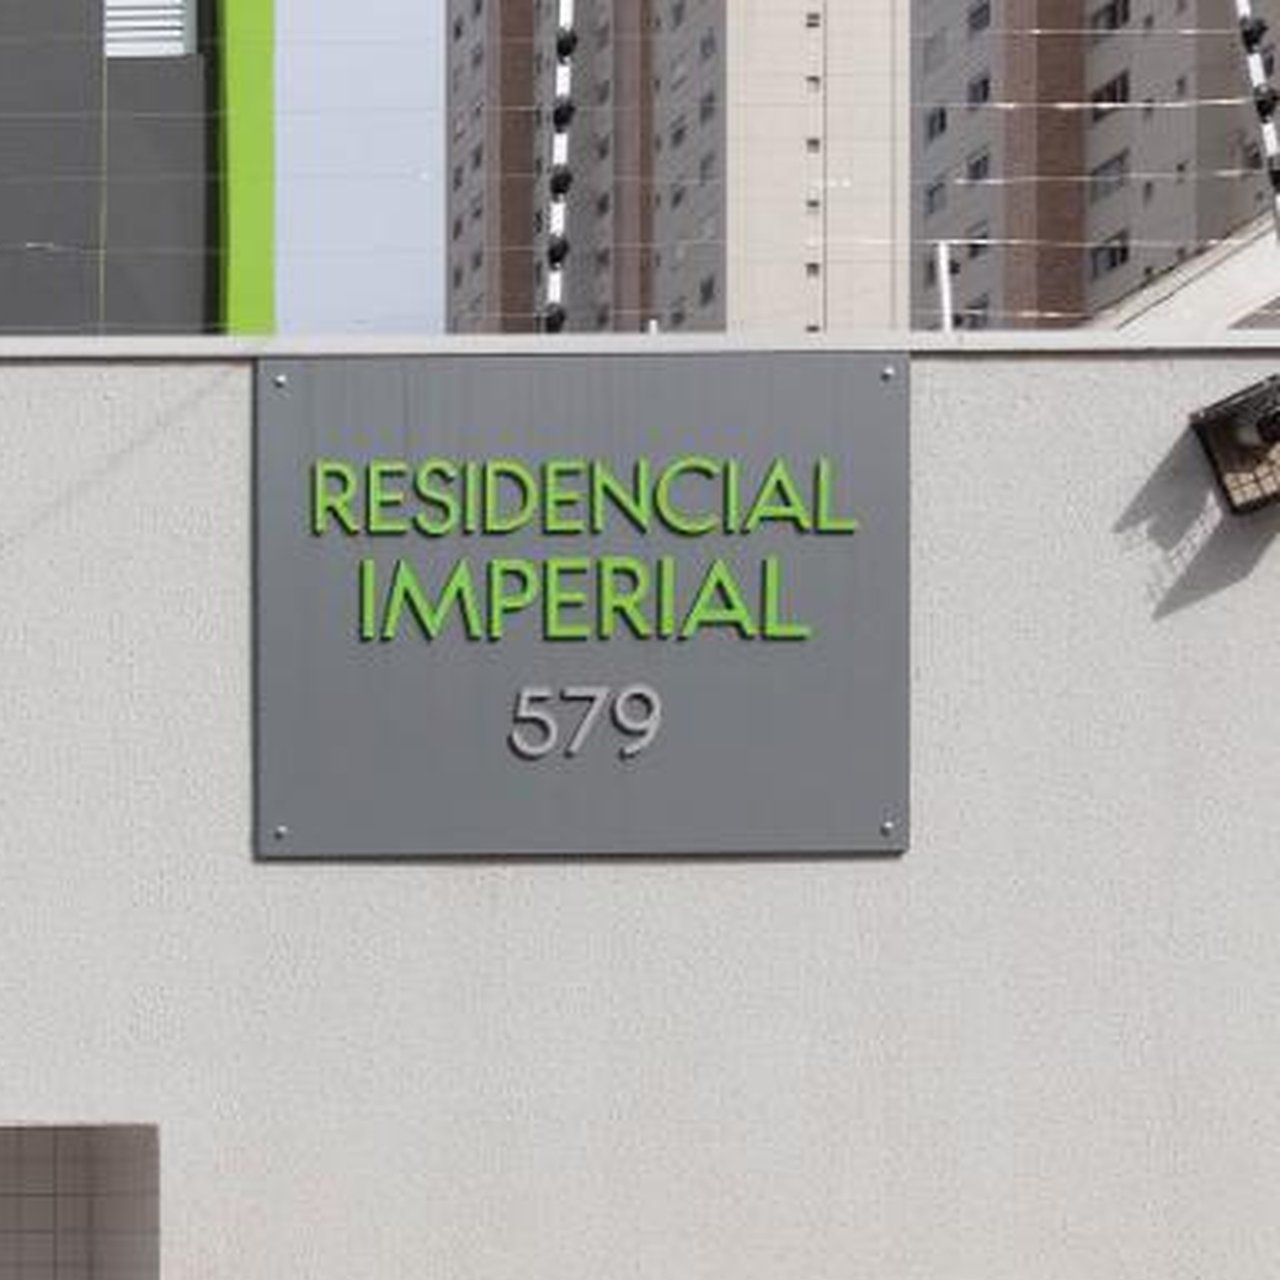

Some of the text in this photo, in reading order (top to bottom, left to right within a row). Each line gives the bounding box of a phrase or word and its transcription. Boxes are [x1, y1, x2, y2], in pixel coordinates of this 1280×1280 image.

[311, 456, 858, 538] RESIDENCIAL
[358, 556, 813, 643] IMPERIAL
[507, 682, 663, 763] 579
